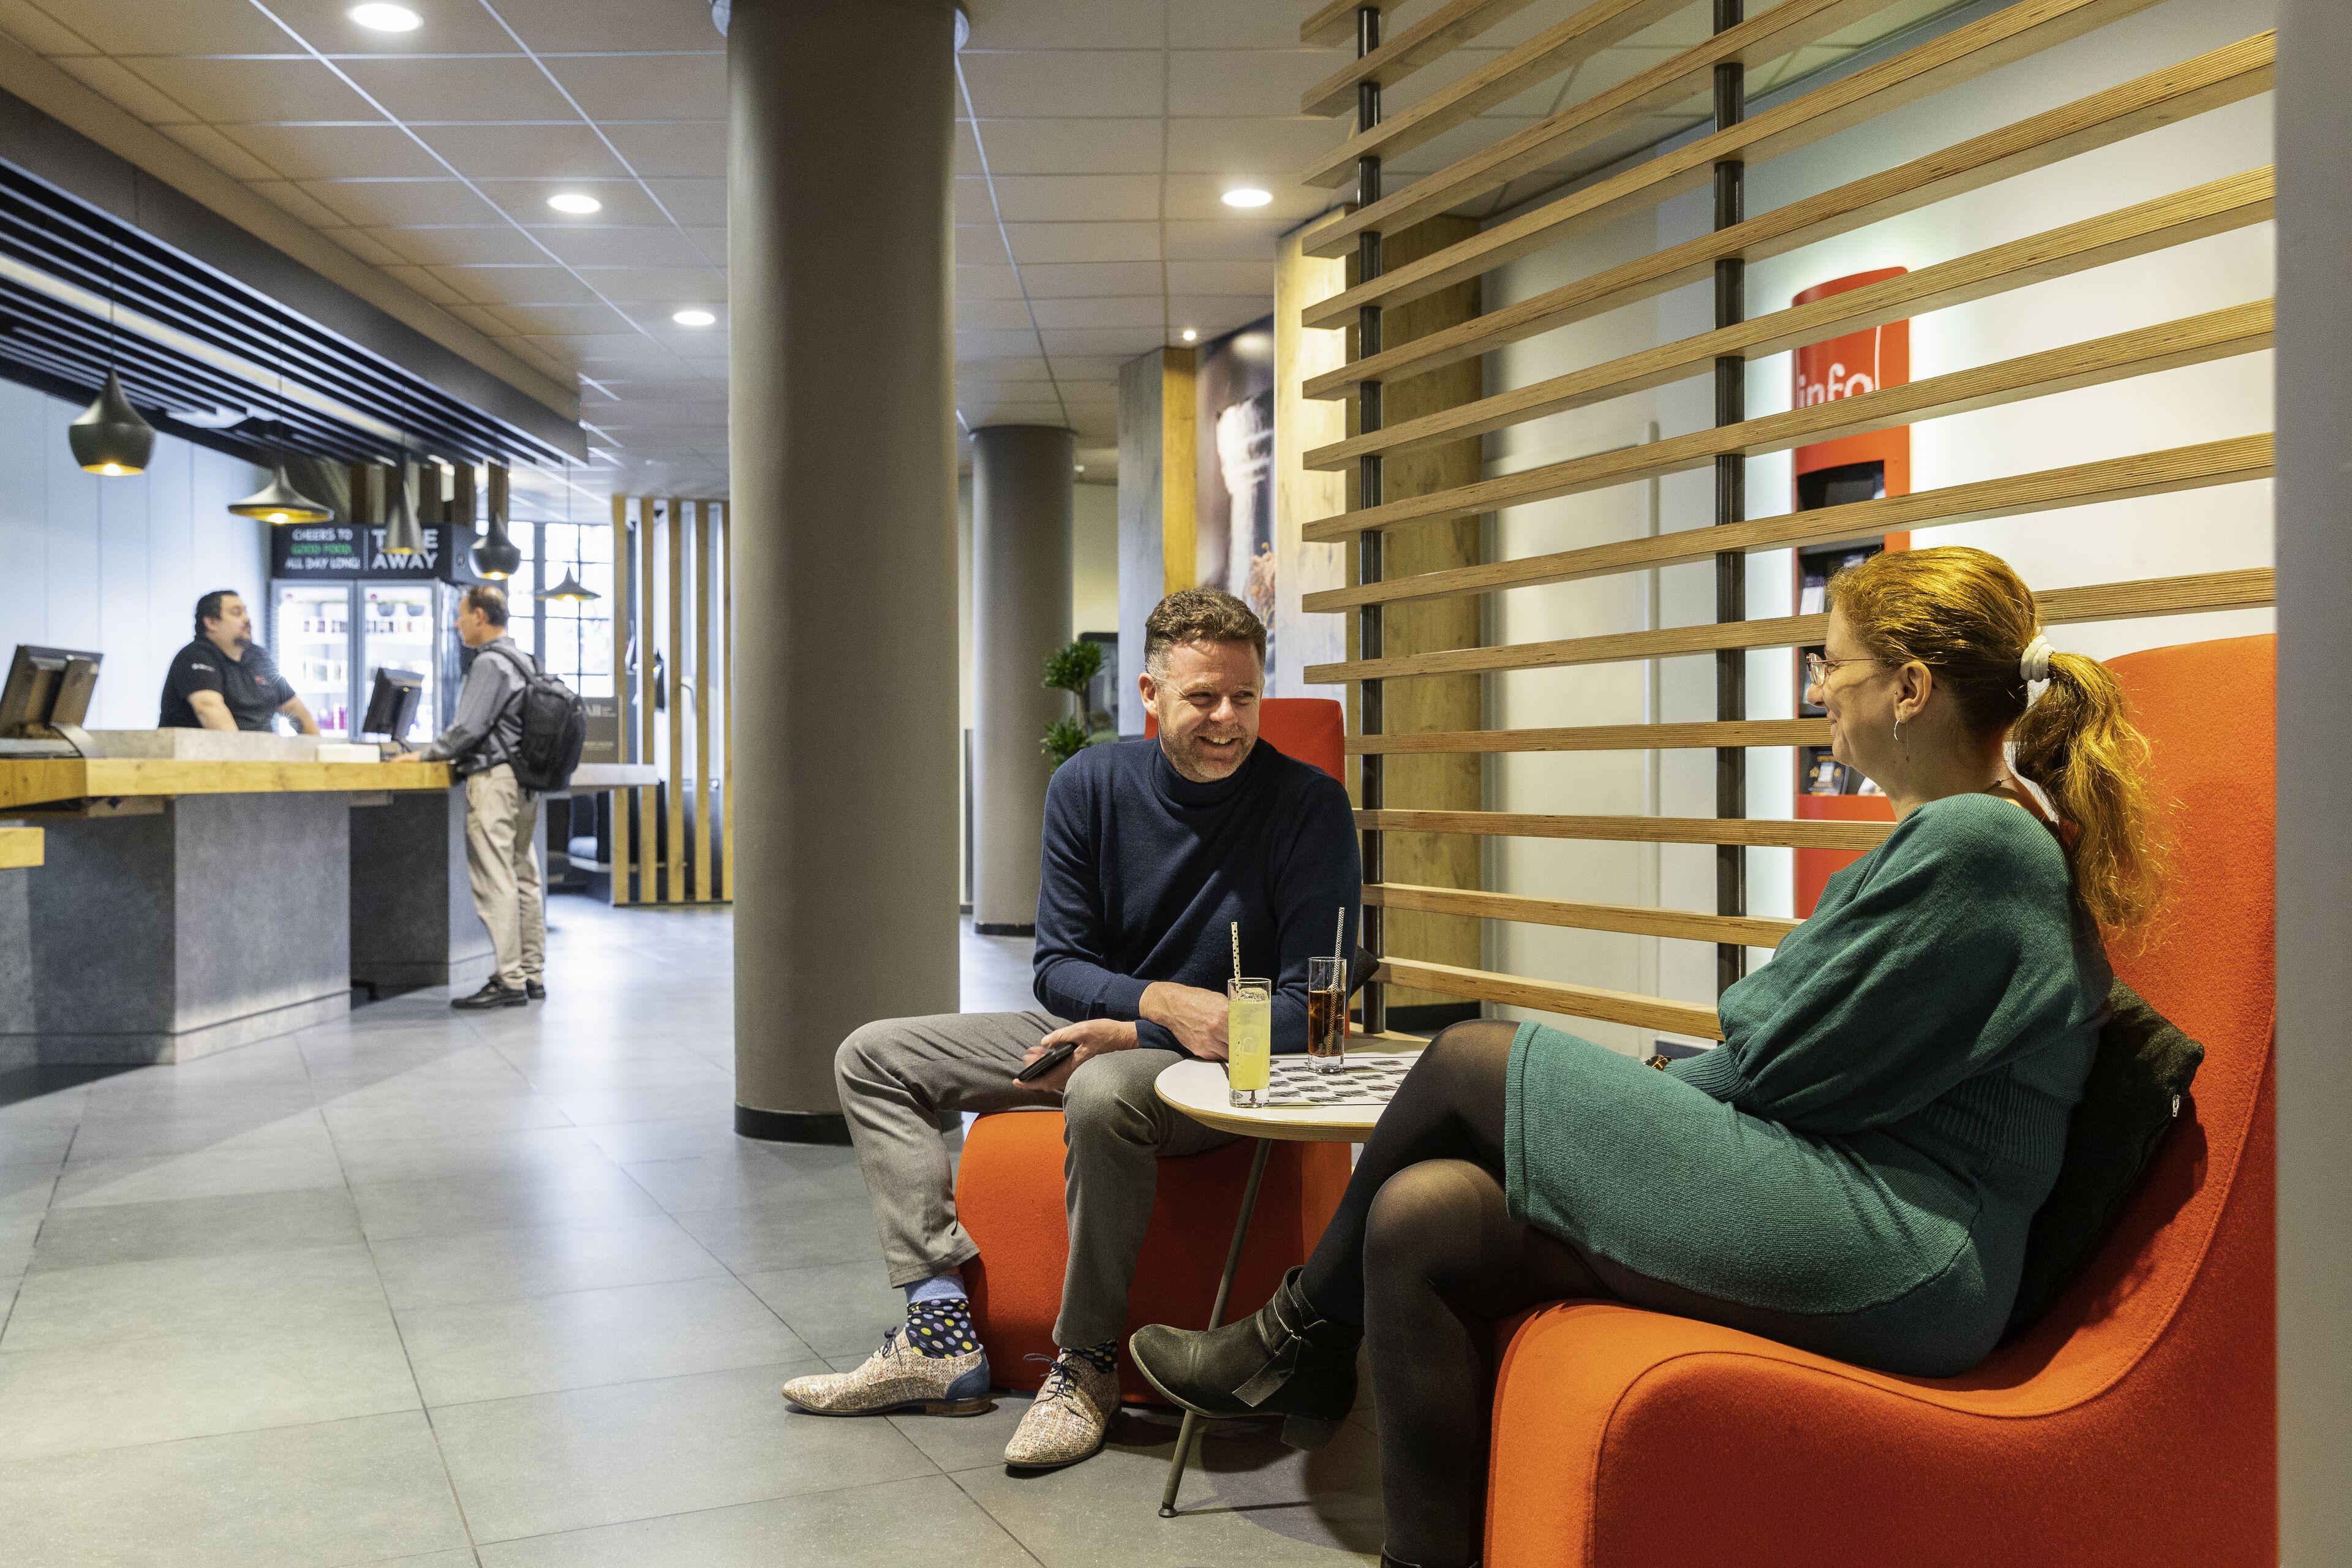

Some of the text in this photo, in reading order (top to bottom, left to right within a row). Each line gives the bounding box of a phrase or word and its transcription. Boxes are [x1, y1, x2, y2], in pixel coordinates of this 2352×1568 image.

[292, 528, 353, 541] CHEERS TO
[371, 529, 439, 549] TE
[285, 557, 304, 570] ALL
[305, 557, 330, 570] DAY
[371, 551, 439, 570] AWAY
